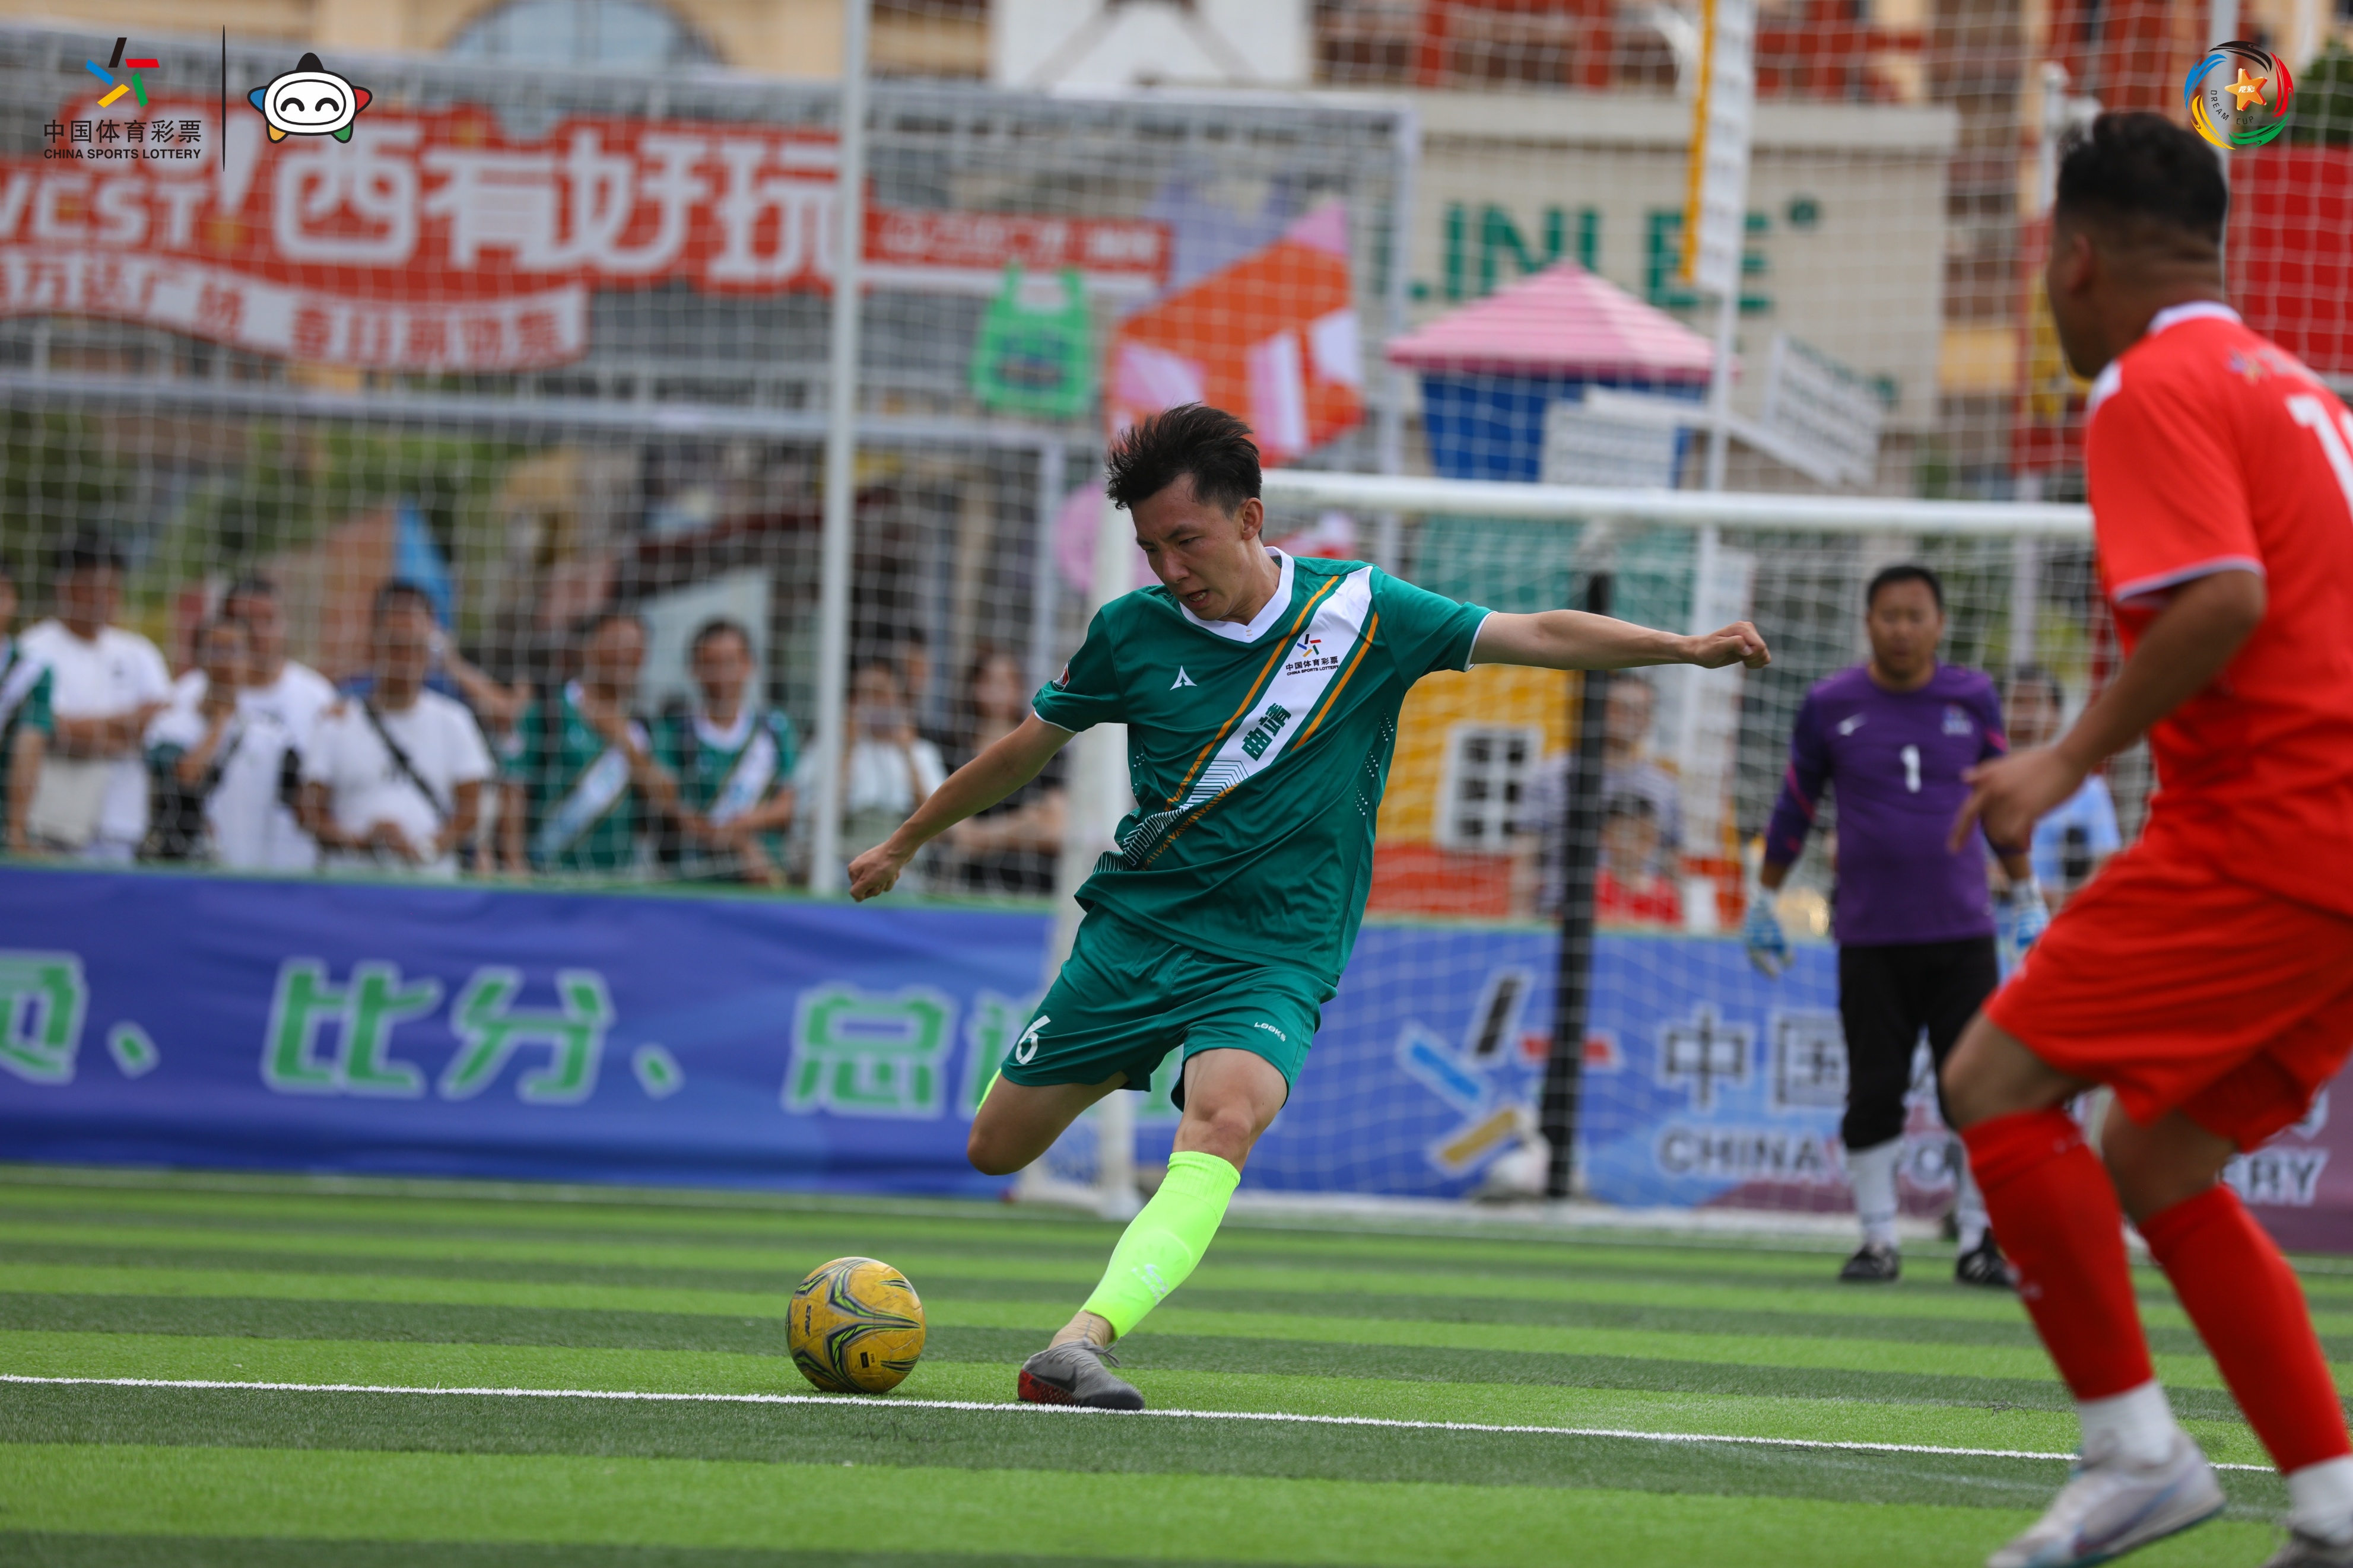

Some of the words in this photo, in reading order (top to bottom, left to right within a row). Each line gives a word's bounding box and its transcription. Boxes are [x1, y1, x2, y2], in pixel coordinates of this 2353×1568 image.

[1285, 656, 1338, 671] 中国体育彩票
[1241, 702, 1291, 762] 曲靖
[1901, 745, 1921, 793] 1
[1015, 1015, 1051, 1064] 6
[1254, 1022, 1286, 1042] LOOKS
